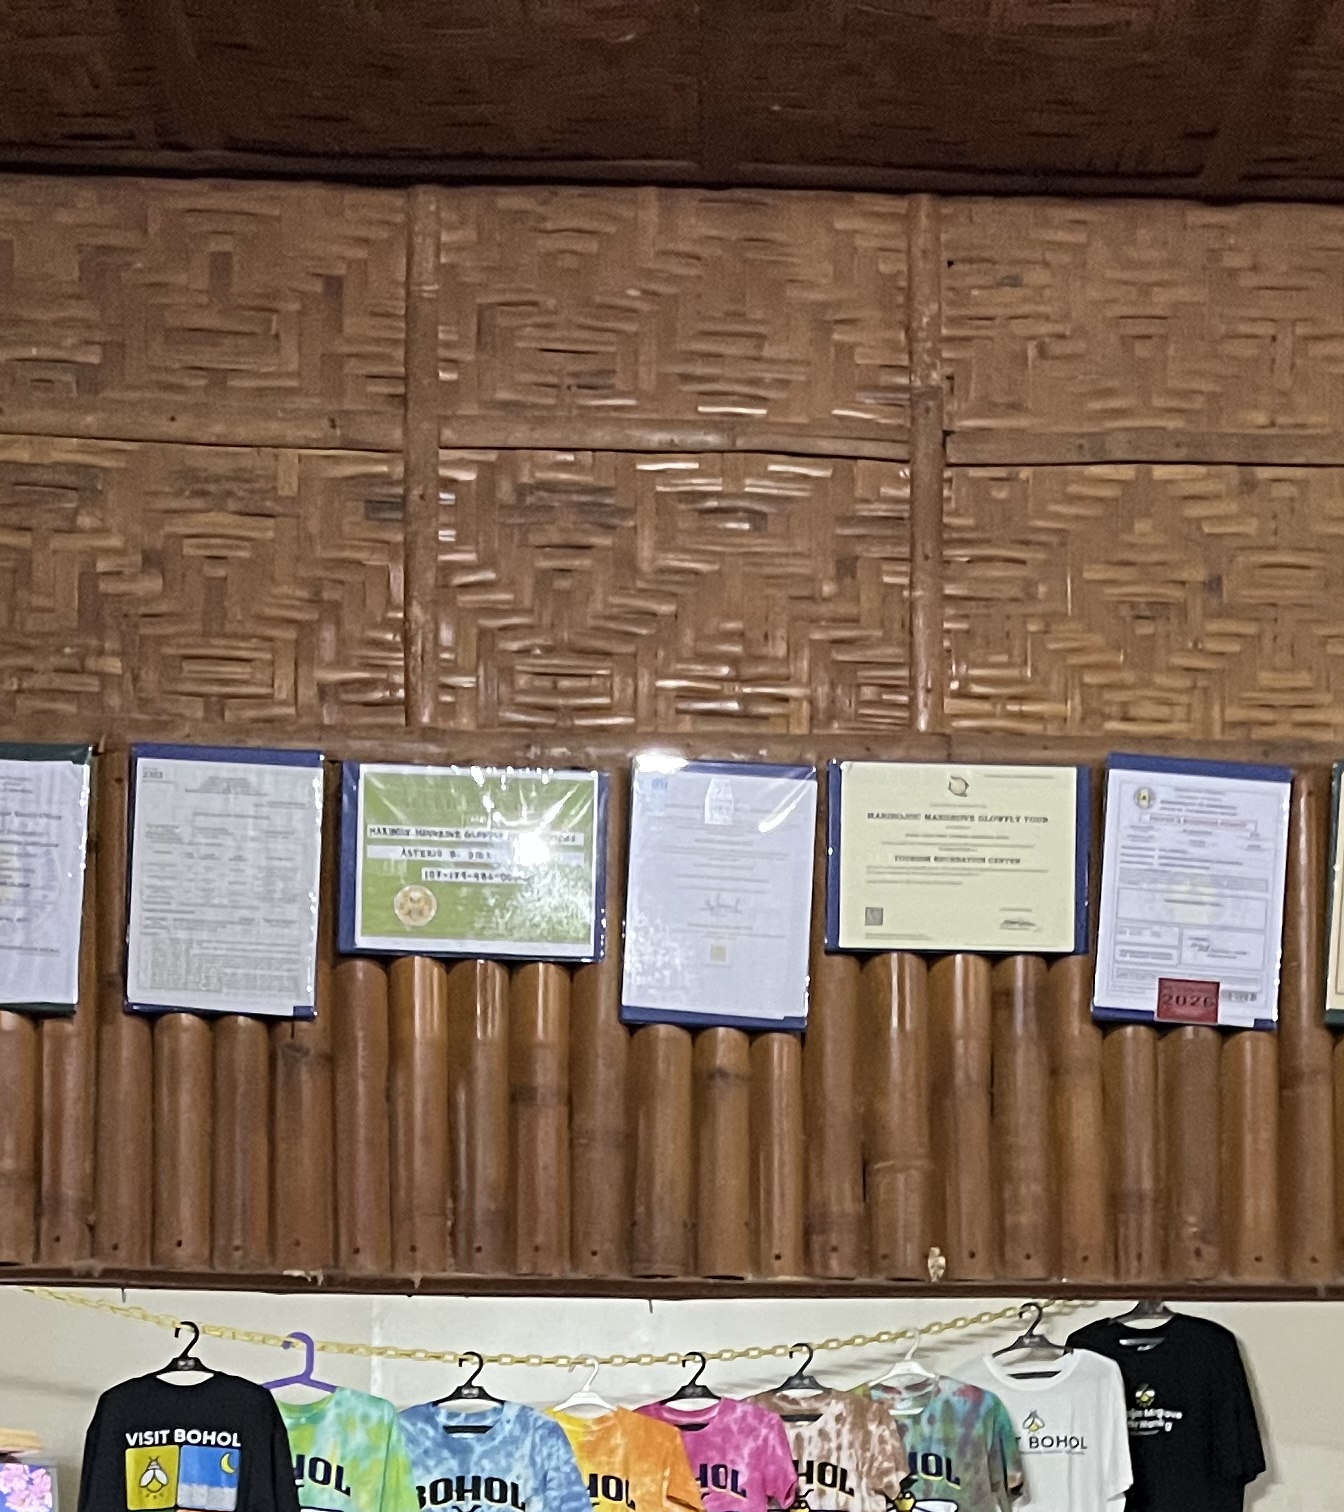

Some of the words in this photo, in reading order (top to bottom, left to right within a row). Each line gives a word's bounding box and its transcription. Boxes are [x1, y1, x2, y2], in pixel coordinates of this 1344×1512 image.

[125, 1429, 171, 1447] VISIT
[174, 1428, 241, 1448] BOHOL
[1029, 1435, 1088, 1450] BOHOL
